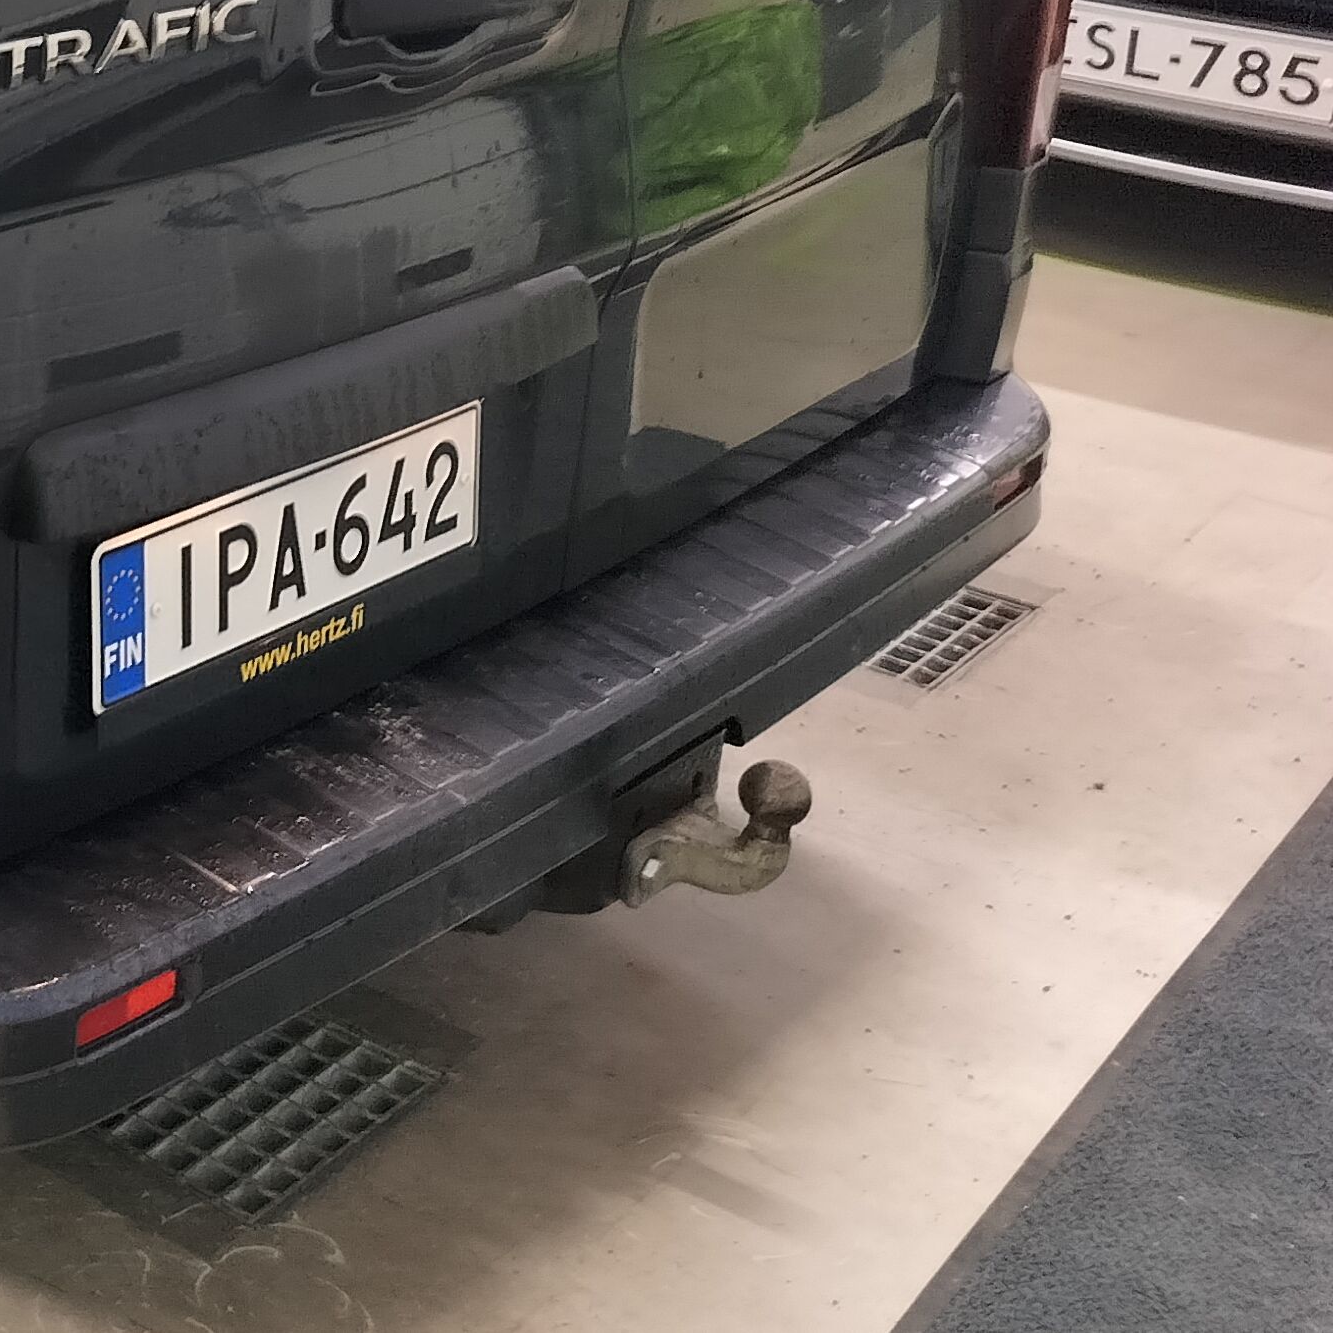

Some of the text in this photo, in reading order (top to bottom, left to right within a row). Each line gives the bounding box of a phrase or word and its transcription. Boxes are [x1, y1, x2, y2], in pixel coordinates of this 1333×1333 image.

[1063, 16, 1321, 106] SL-785
[180, 441, 460, 649] IPA-642
[103, 631, 143, 679] FIN
[239, 602, 365, 683] www.hertz.fi
